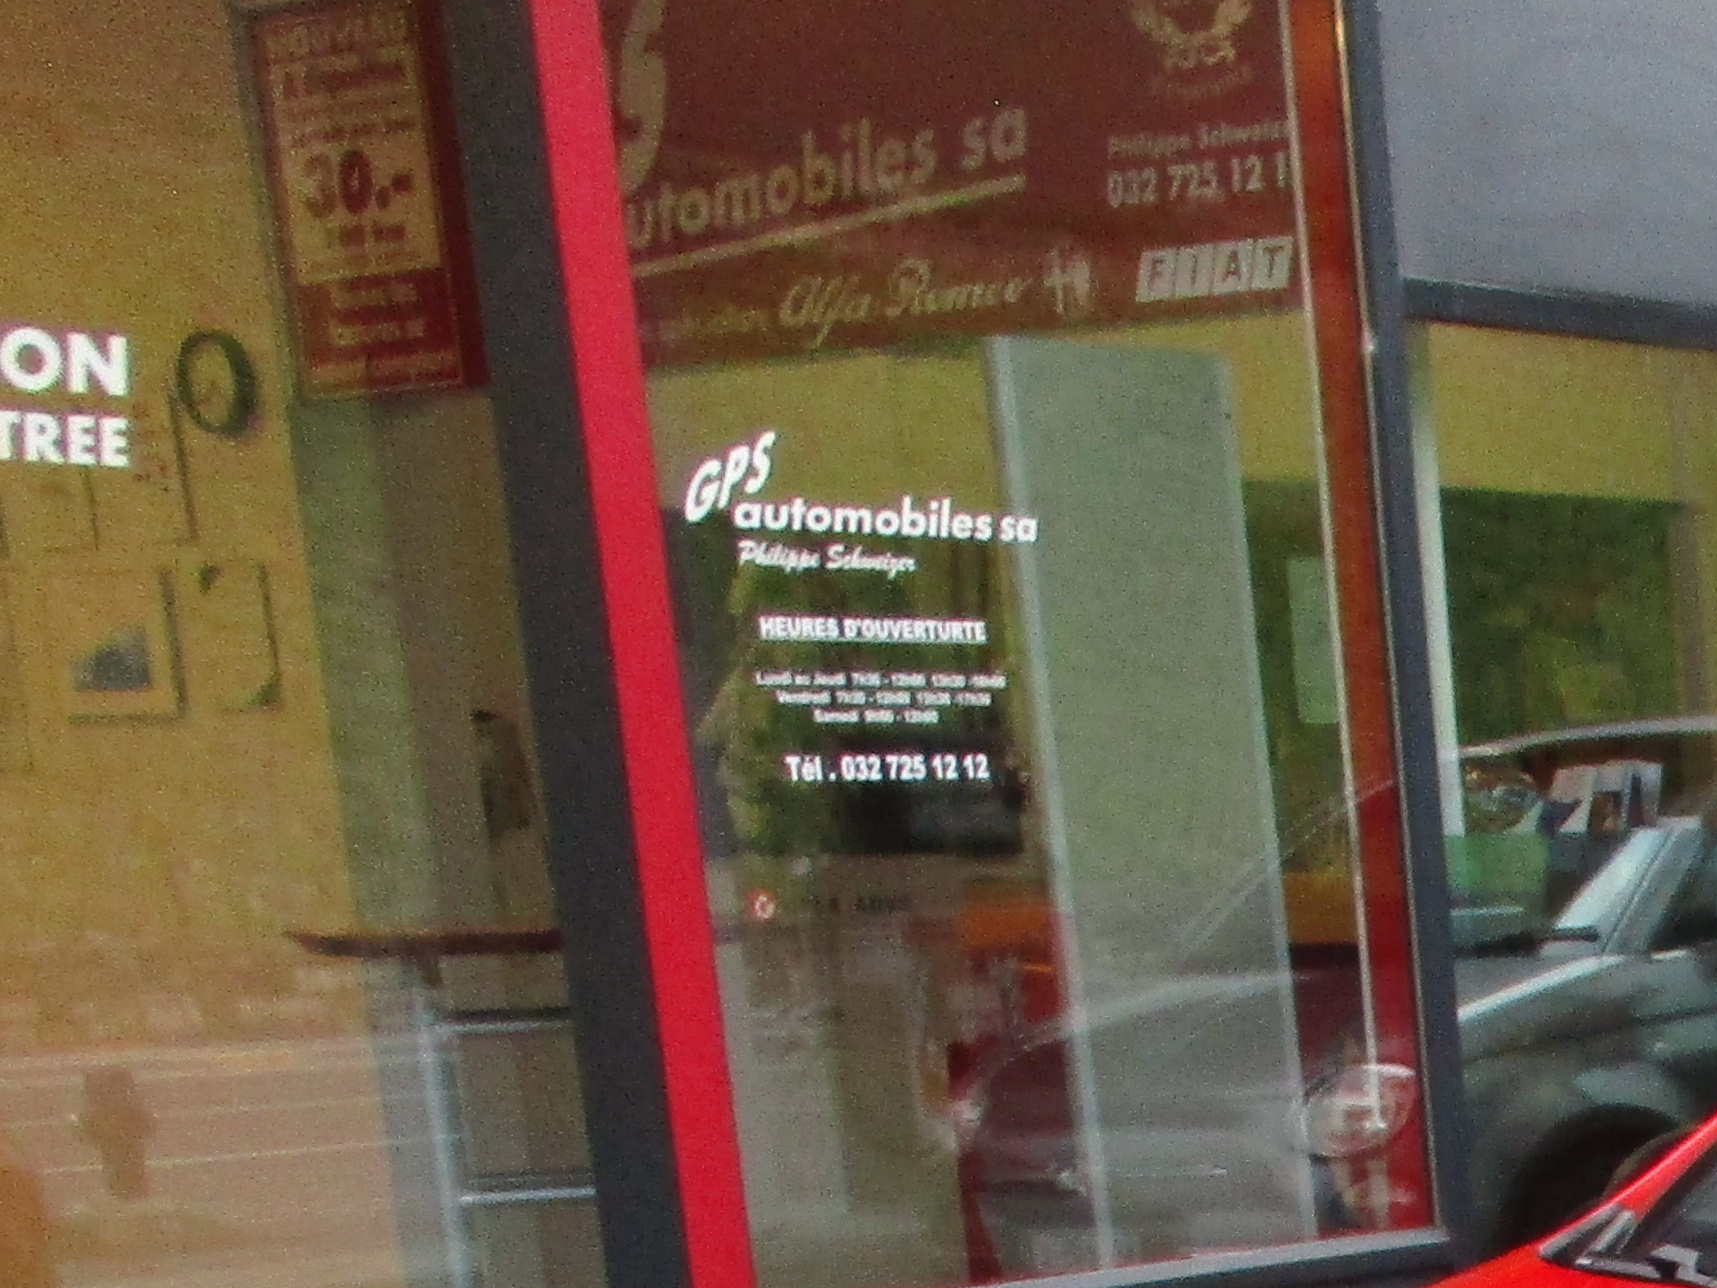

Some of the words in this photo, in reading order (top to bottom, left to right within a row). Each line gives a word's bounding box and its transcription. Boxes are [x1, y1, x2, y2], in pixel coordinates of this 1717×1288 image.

[628, 117, 937, 250] utomobiles
[960, 107, 1027, 171] sa
[1107, 166, 1157, 207] 032
[1167, 160, 1224, 200] 725
[1231, 154, 1265, 193] 12
[1145, 242, 1288, 292] FIAT
[685, 430, 776, 524] GPS
[733, 495, 992, 543] automobiles
[999, 513, 1039, 543] sa
[758, 615, 840, 641] HEURES
[840, 754, 883, 782] 032
[885, 754, 928, 782] 725
[931, 754, 959, 782] 12
[963, 754, 991, 782] 12
